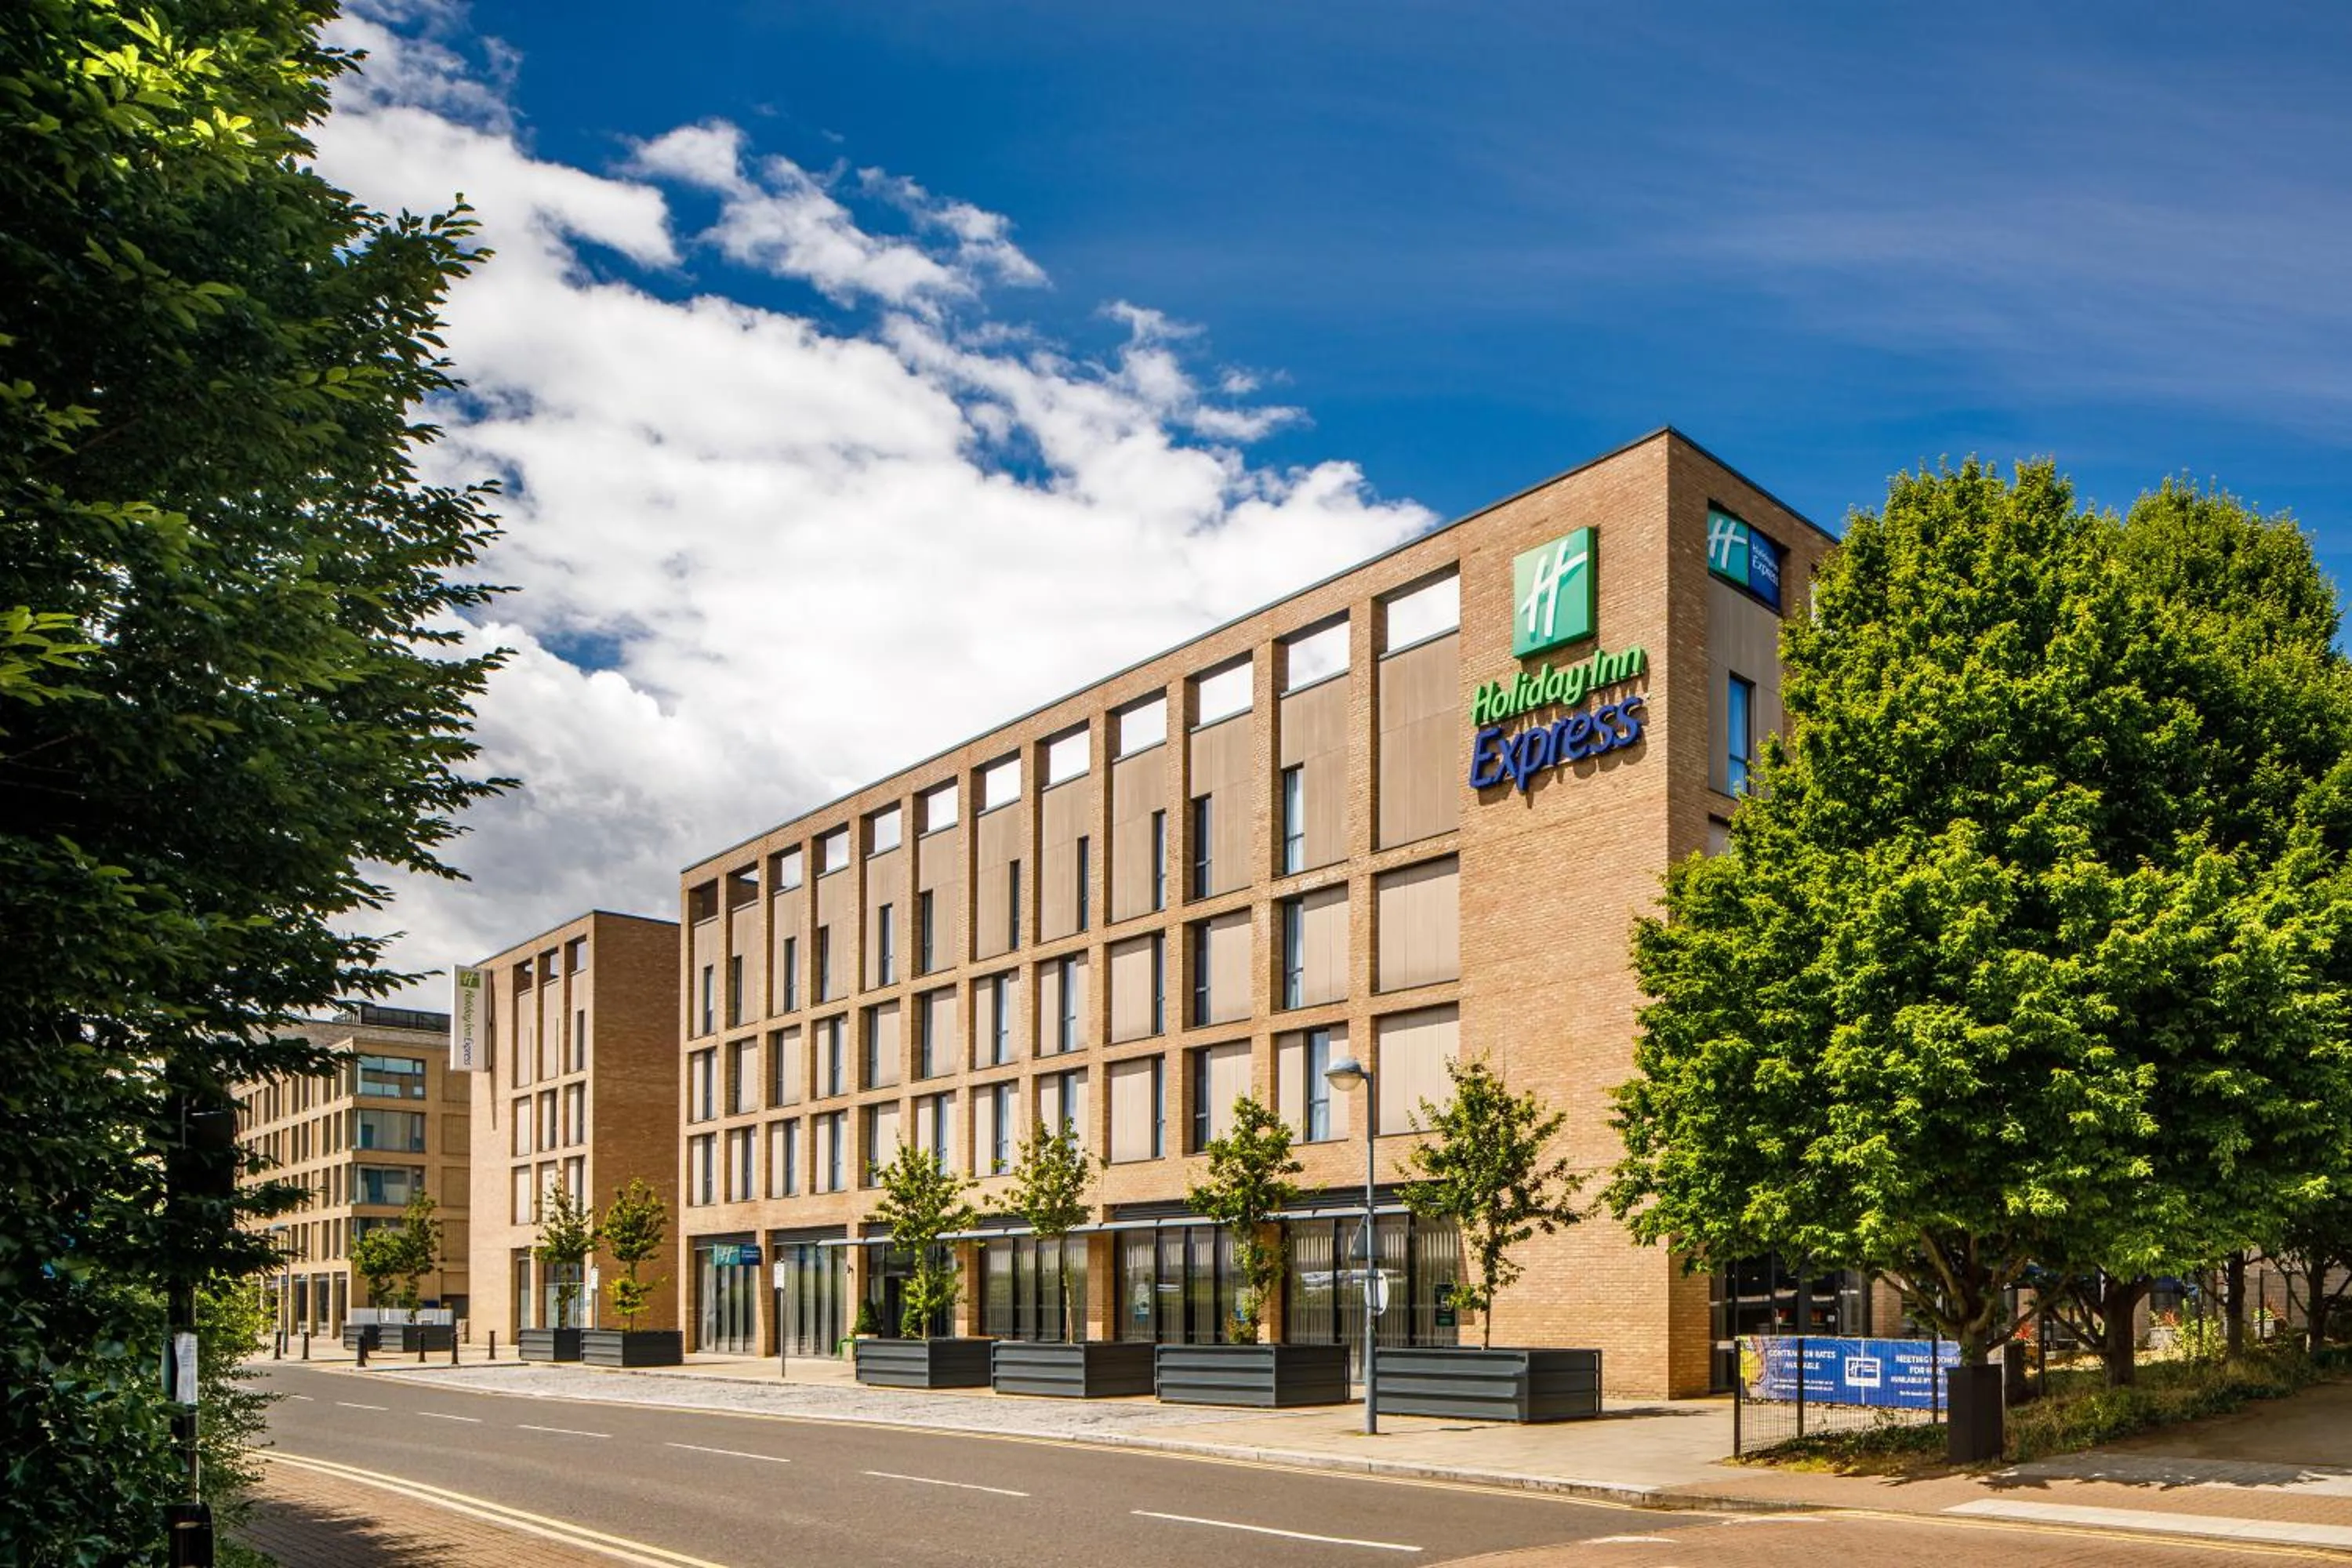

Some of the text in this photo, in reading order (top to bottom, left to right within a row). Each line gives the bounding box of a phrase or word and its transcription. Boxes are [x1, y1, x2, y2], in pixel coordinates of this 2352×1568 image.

[1471, 645, 1647, 727] Holiday Inn
[1469, 695, 1644, 793] Express
[1767, 1349, 1814, 1358] CONTRAOR
[1909, 1366, 1925, 1374] FOR
